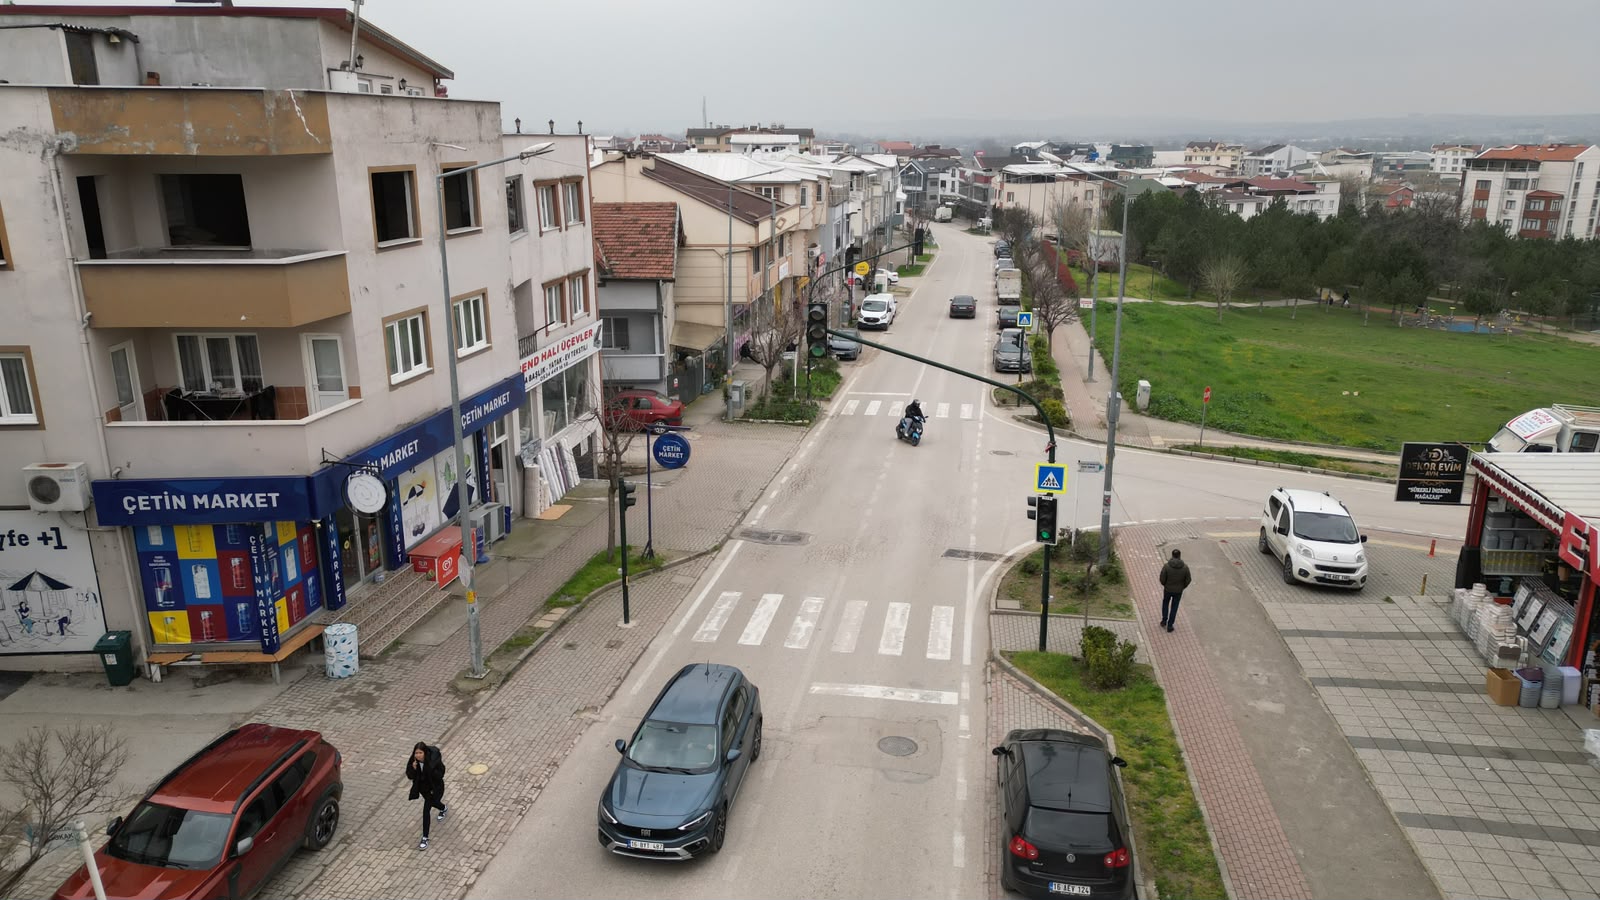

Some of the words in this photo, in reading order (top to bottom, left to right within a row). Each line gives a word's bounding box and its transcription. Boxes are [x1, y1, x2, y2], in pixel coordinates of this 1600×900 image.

[520, 356, 539, 373] END
[541, 345, 559, 362] HALI
[461, 404, 483, 431] ÇETİN
[483, 391, 511, 416] MARKET
[380, 439, 419, 471] MARKET
[658, 451, 684, 459] MARKET
[1438, 461, 1462, 472] EVİM
[122, 491, 187, 515] ÇETİN
[192, 492, 280, 509] MARKET
[37, 526, 67, 549] +1
[392, 503, 402, 562] MARKET
[330, 538, 342, 602] MARKET
[249, 535, 262, 584] ÇETİN
[256, 589, 270, 646] MARKET
[258, 534, 270, 582] ÇETİN
[266, 587, 278, 644] MARKET
[1053, 883, 1061, 891] 16
[1078, 886, 1090, 894] 124
